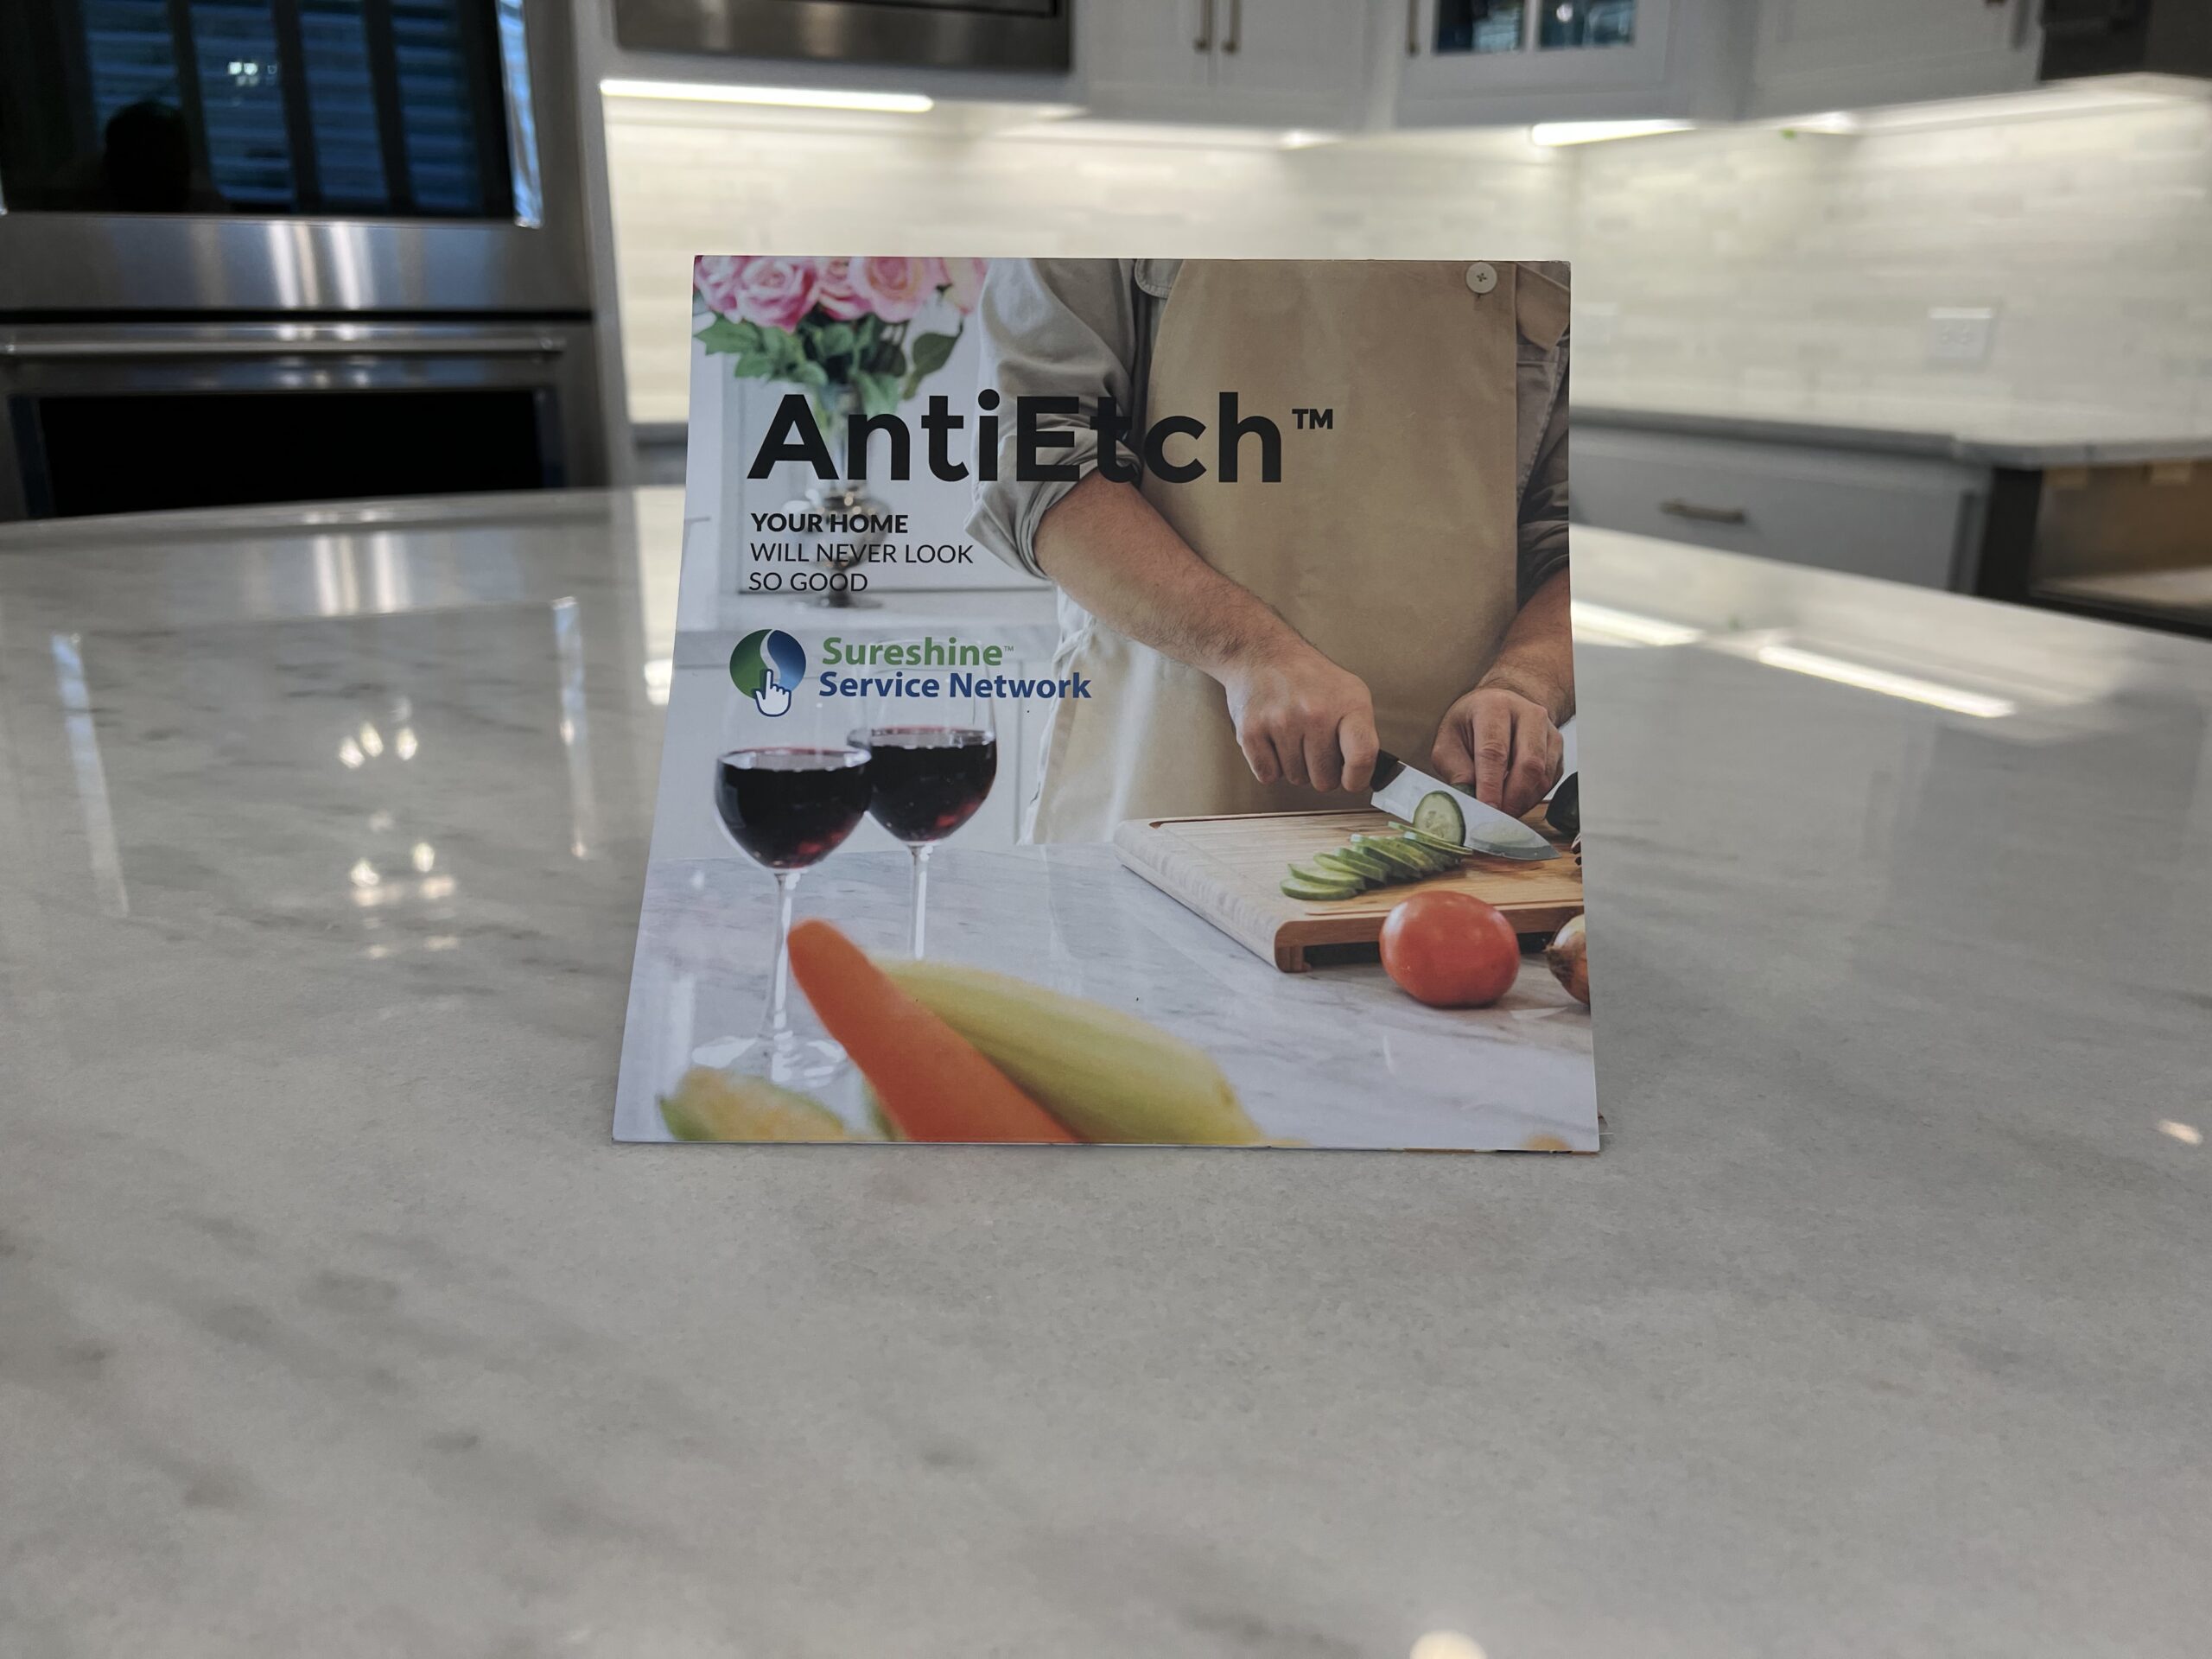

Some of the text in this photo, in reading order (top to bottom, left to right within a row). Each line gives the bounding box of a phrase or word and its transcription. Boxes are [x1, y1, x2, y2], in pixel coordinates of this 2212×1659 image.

[751, 512, 908, 534] YOUR HOME
[750, 543, 974, 564] WILL NEVER LOOK
[748, 572, 868, 593] SO GOOD
[818, 671, 1091, 699] Service Network
